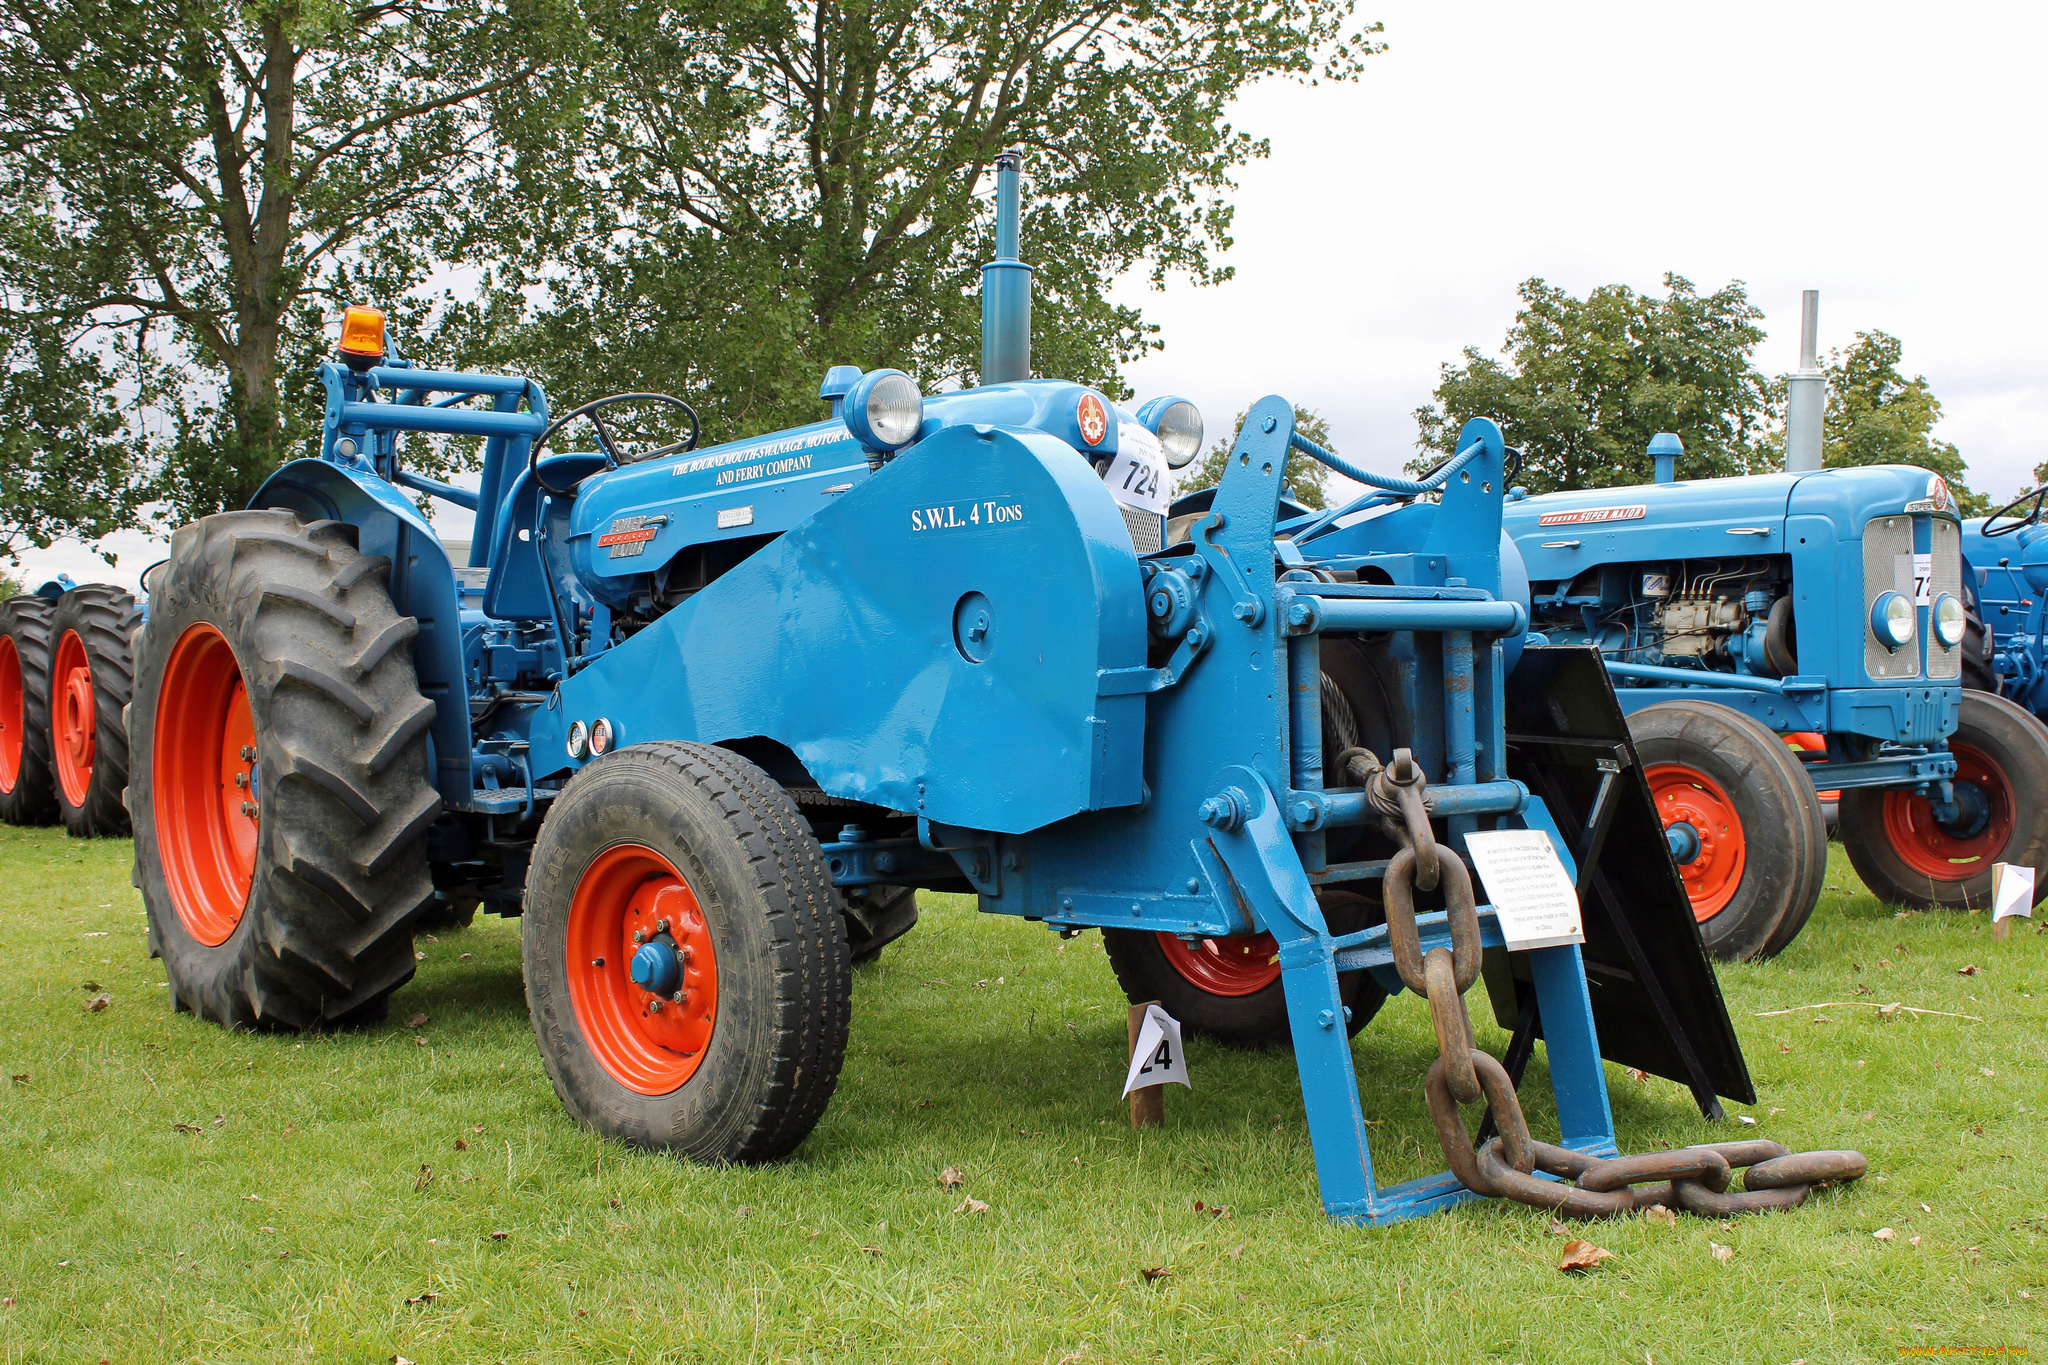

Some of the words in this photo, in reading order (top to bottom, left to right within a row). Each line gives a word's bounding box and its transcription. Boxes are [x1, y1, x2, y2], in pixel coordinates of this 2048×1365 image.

[671, 464, 689, 477] THE
[688, 439, 804, 473] BOURNEMOUTH-SWANAGE
[804, 430, 843, 450] MOTOR
[715, 471, 735, 486] AND
[735, 463, 766, 483] FERRY
[766, 453, 814, 477] COMPANY
[1122, 460, 1159, 499] 724
[911, 505, 966, 532] S.W.L.
[970, 503, 980, 525] 4
[1541, 514, 1579, 524] FORDSON
[1578, 511, 1610, 522] SUPER
[1609, 507, 1642, 520] MAJOR
[1909, 503, 1931, 511] SUPER
